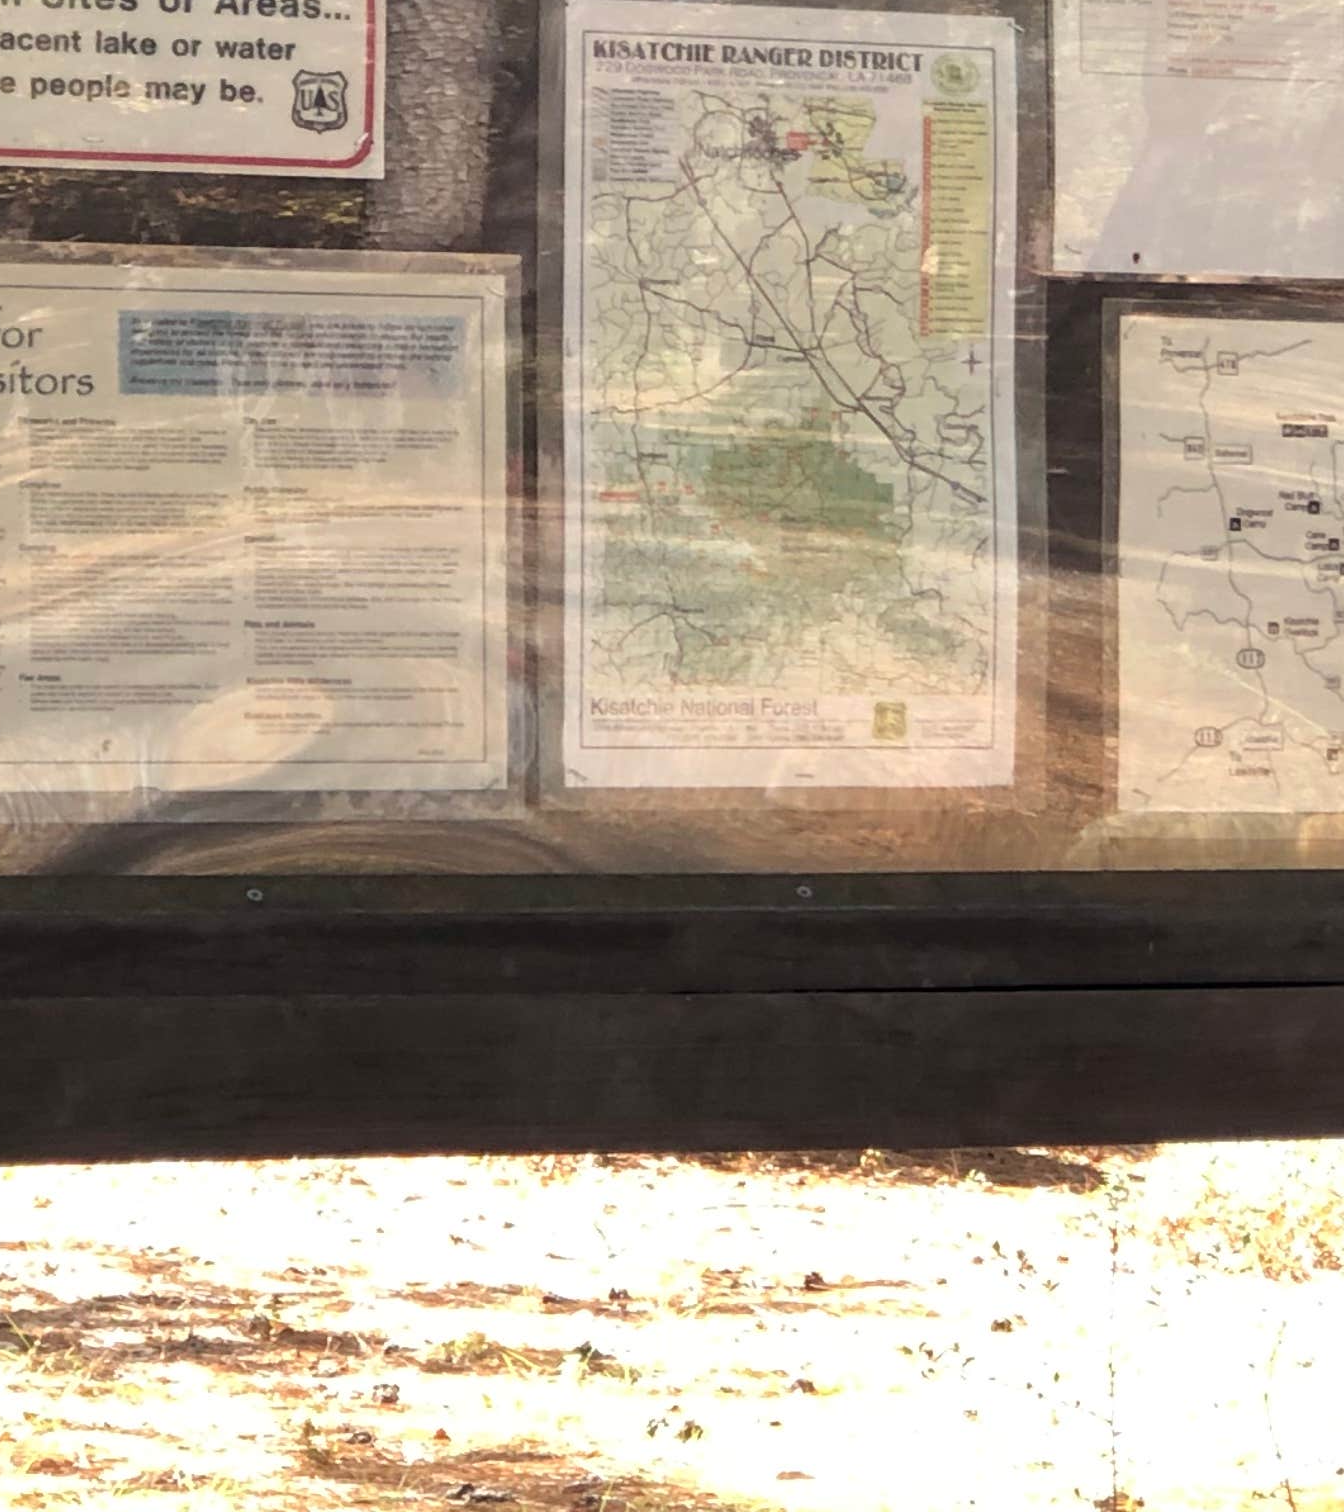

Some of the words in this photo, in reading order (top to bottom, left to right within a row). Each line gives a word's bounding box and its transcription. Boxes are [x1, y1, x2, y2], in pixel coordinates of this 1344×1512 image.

[95, 32, 157, 57] lake
[171, 37, 203, 59] or
[215, 38, 296, 62] water
[593, 39, 715, 64] KISATCHIE
[722, 44, 812, 68] RANGER
[819, 49, 924, 72] DISTRICT
[30, 75, 131, 101] people
[145, 80, 206, 104] may
[219, 79, 264, 104] be.
[590, 697, 674, 716] Kisatchie
[681, 698, 754, 716] National
[761, 698, 818, 716] Forest
